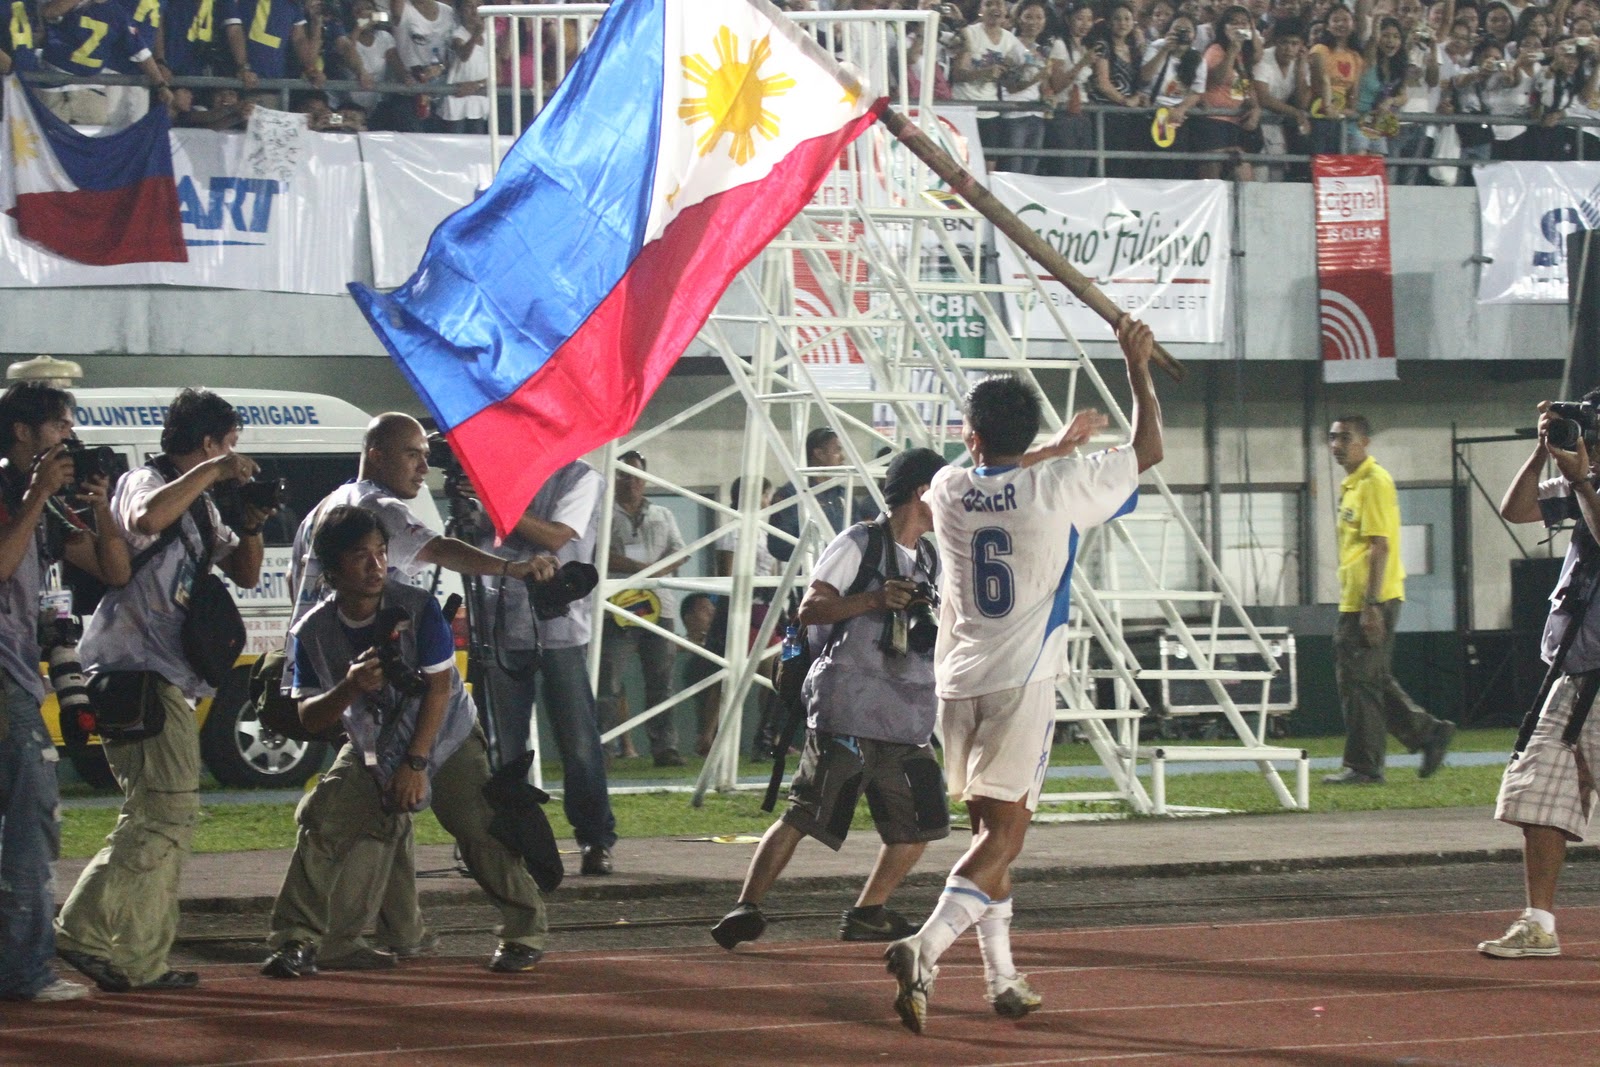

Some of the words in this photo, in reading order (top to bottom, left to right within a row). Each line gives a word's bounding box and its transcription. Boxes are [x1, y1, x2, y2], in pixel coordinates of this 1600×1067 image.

[70, 15, 109, 68] Z
[1326, 177, 1381, 218] cignal
[1096, 210, 1211, 285] Filipino
[1342, 226, 1382, 241] CLEAR
[76, 405, 169, 426] OLUNTEER
[241, 405, 320, 425] BRIGADE
[970, 525, 1016, 619] 6
